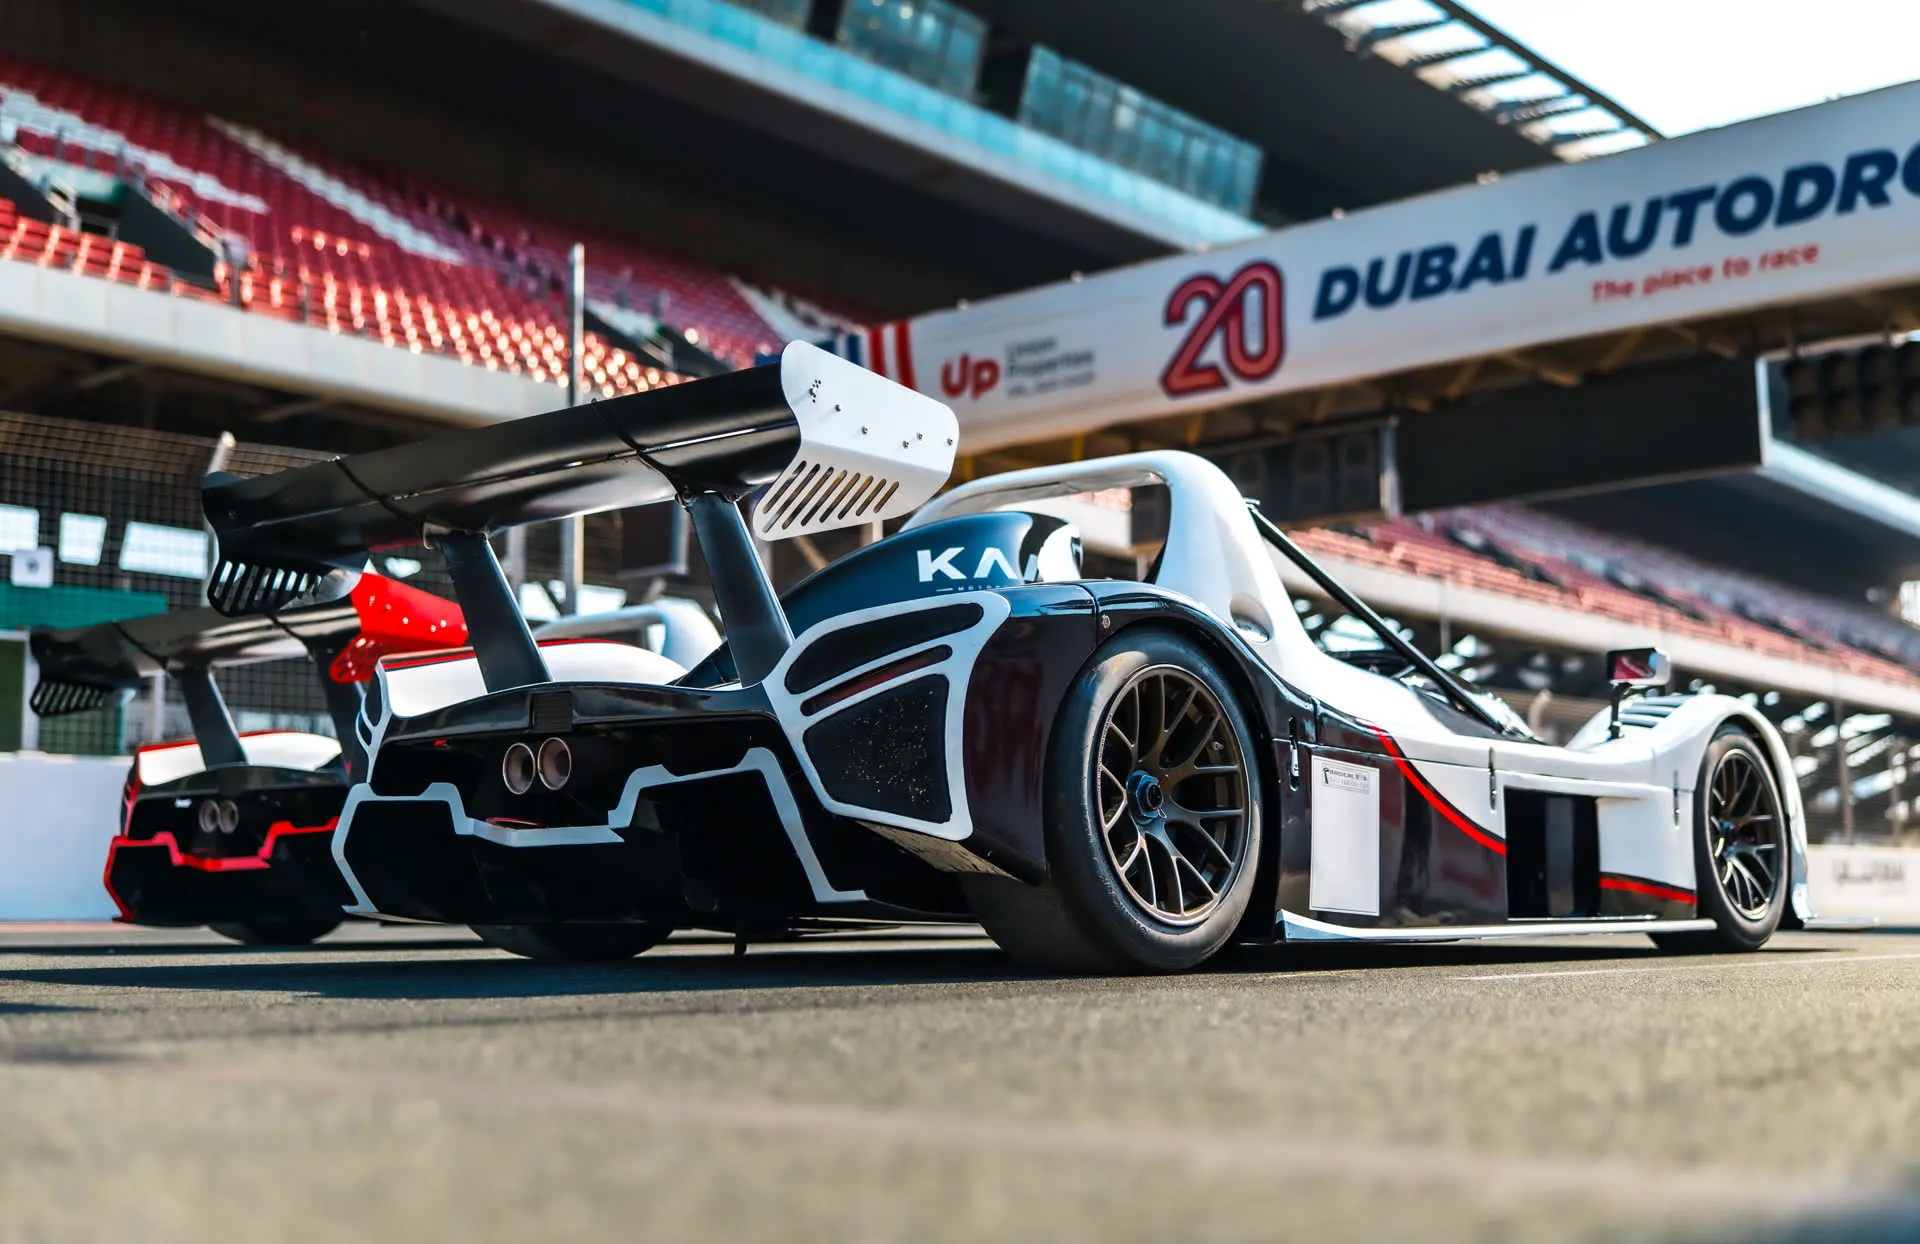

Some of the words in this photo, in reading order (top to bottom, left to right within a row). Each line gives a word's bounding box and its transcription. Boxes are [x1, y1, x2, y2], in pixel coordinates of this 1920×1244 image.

[1313, 225, 1535, 320] DUBAI
[1642, 264, 1713, 296] place
[1722, 257, 1751, 279] to
[1759, 243, 1819, 272] race
[1159, 260, 1286, 398] 20
